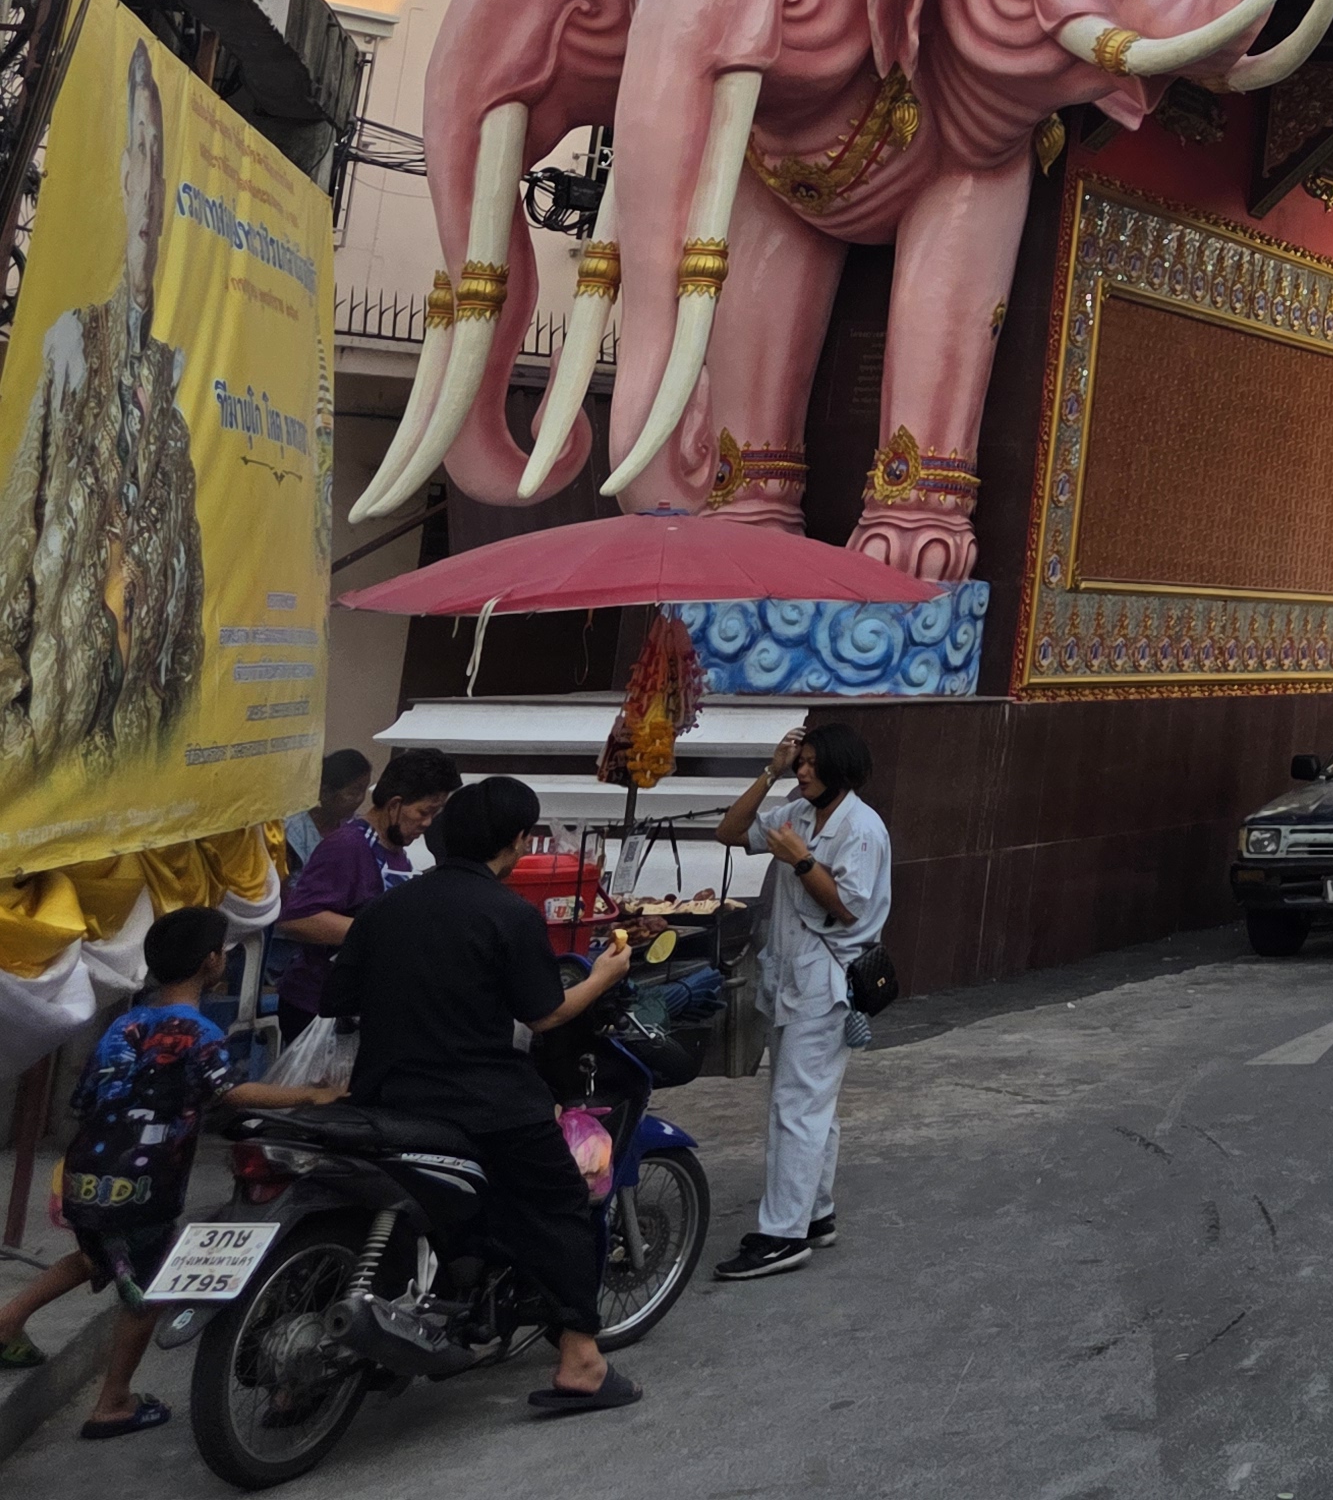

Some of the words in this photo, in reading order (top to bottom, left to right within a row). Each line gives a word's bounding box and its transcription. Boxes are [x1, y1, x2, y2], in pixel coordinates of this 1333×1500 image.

[199, 1229, 254, 1249] 3กษ
[171, 1254, 255, 1271] กรุงเทพมหานคร
[168, 1274, 234, 1293] 1795
